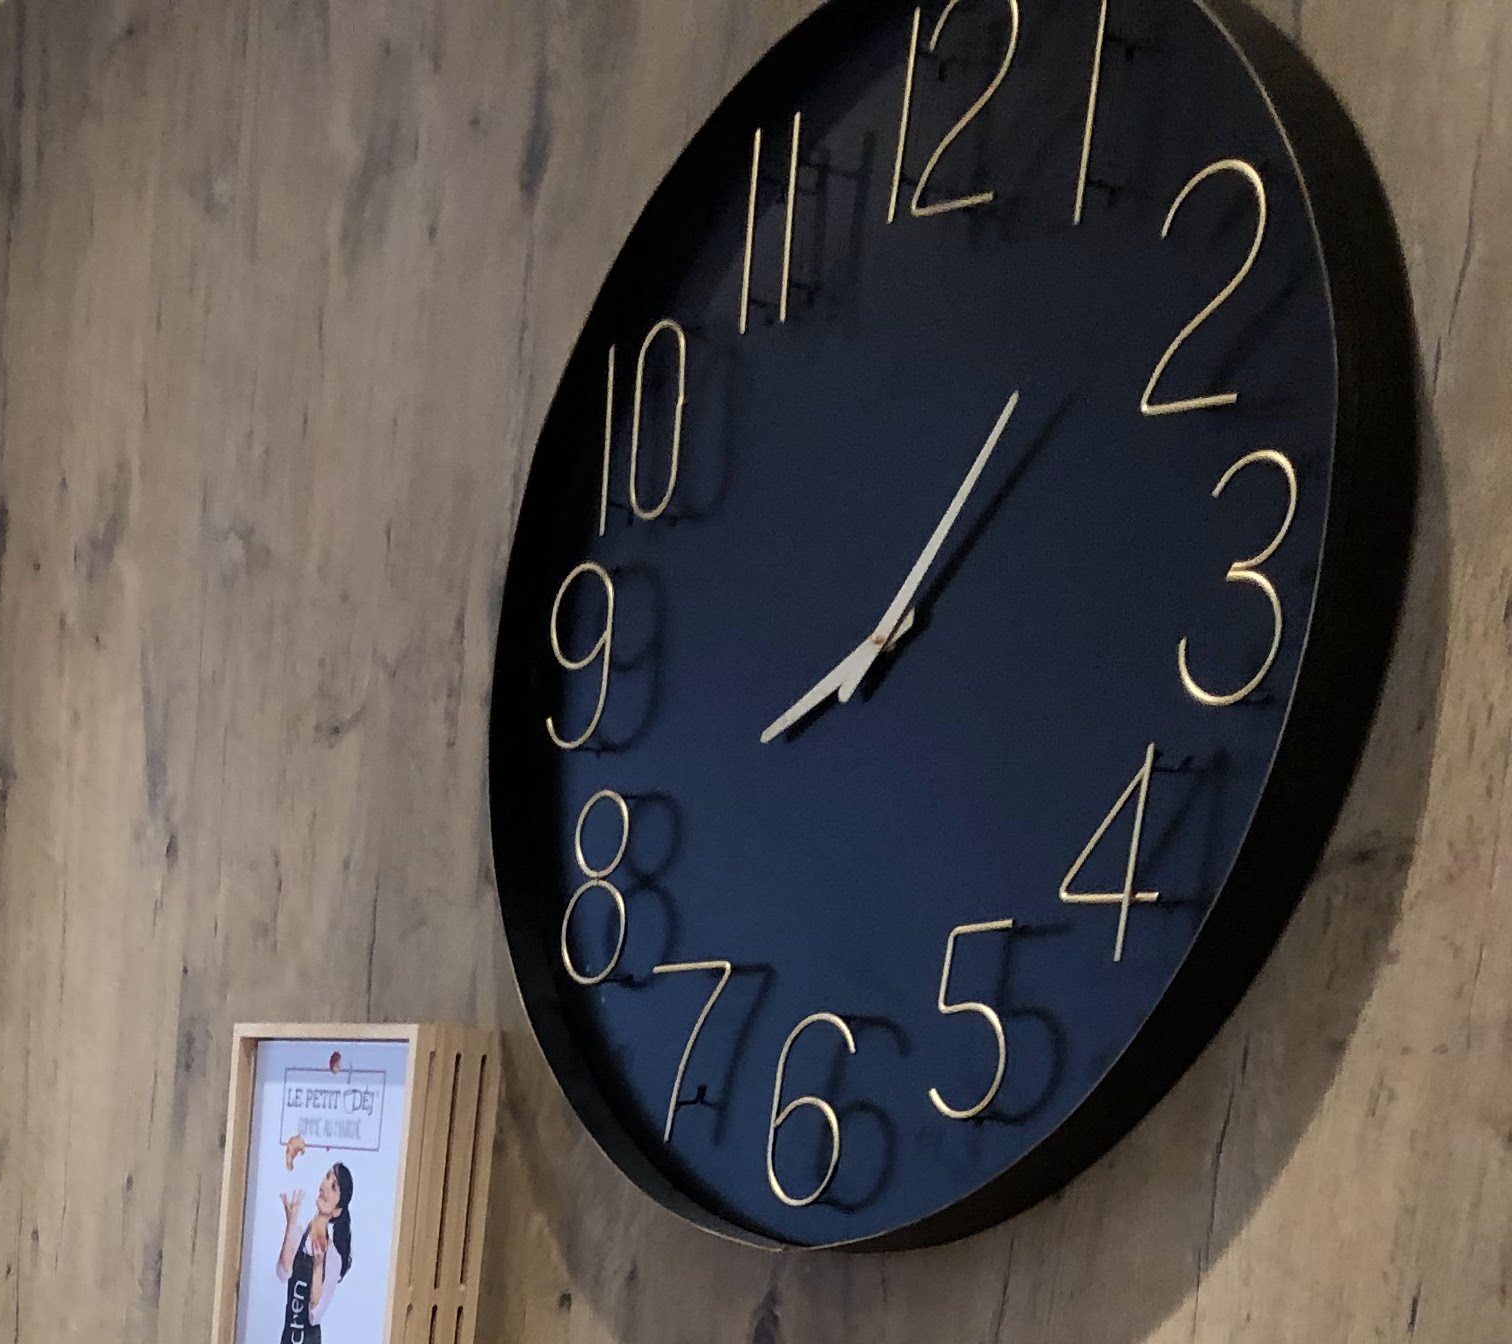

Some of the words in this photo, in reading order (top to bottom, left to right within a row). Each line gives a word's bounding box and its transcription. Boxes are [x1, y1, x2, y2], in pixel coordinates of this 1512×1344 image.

[738, 109, 802, 335] 11
[887, 0, 1020, 224] 12
[1073, 0, 1107, 226] 1
[1139, 156, 1268, 417] 2
[598, 318, 687, 537] 10
[545, 560, 616, 750] 9
[1175, 448, 1299, 707] 3
[559, 788, 630, 986] 8
[1058, 741, 1161, 963] 4
[651, 959, 732, 1144] 7
[765, 1011, 857, 1207] 6
[928, 917, 1016, 1120] 5
